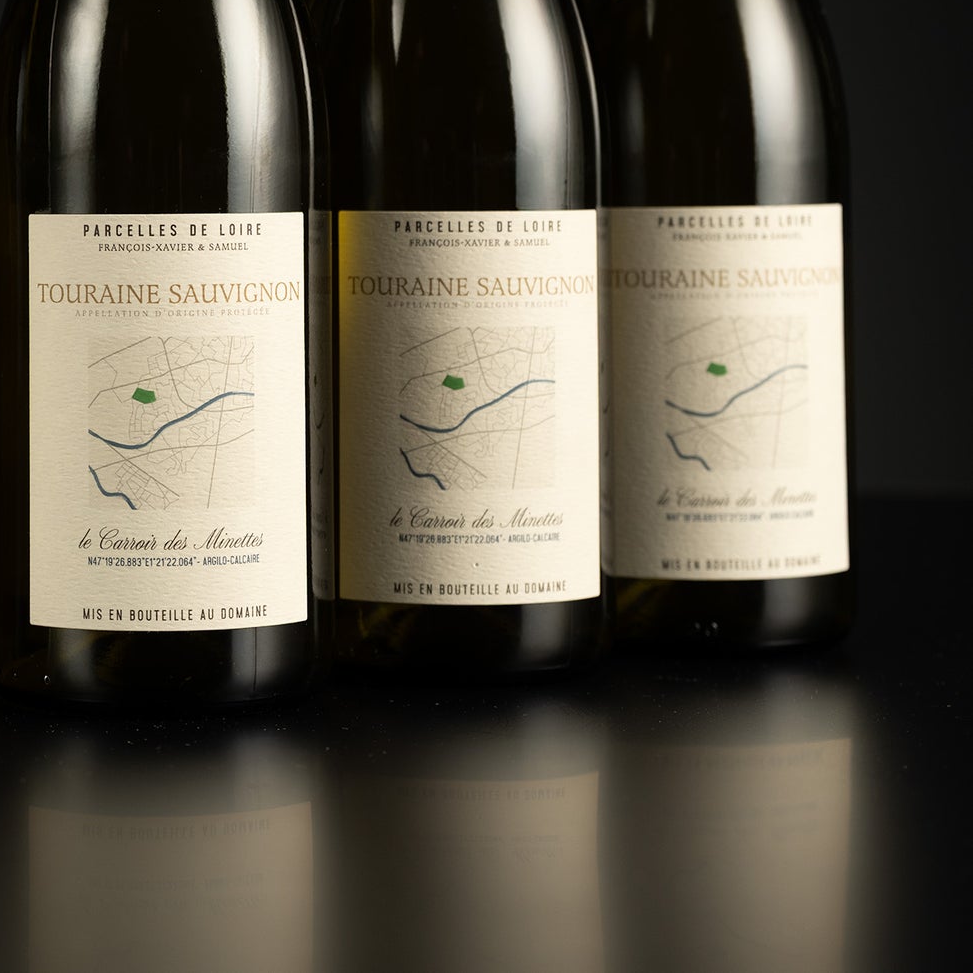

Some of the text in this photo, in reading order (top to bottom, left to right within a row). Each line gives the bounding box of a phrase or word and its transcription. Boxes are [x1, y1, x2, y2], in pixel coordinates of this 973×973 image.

[84, 223, 262, 237] PARCELLES DE LOIRE
[395, 220, 562, 233] PARCELLES DE LOIRE
[98, 243, 194, 253] FRANÇOIS-XAVIER
[209, 243, 249, 251] SAMUEL
[409, 239, 500, 248] FRANÇOIS-XAVIER
[514, 238, 550, 246] SAMUEL
[348, 275, 594, 296] TOURAINE SAUVIGNON
[611, 269, 731, 289] TOURAINE
[37, 281, 300, 304] TOURAINE SAUVIGNON
[75, 309, 148, 317] APPELLATION
[220, 307, 270, 316] PROTÉGÉE
[390, 506, 563, 529] le Carroir des Minettes
[78, 527, 264, 551] le Carroir des Minettes
[203, 554, 259, 566] ARGILO-CALCAIRE
[394, 580, 566, 595] MIS EN BOUTEILLE AU DOMAINE
[83, 605, 267, 621] MIS EN BOUTEILLE AU DOMAINE
